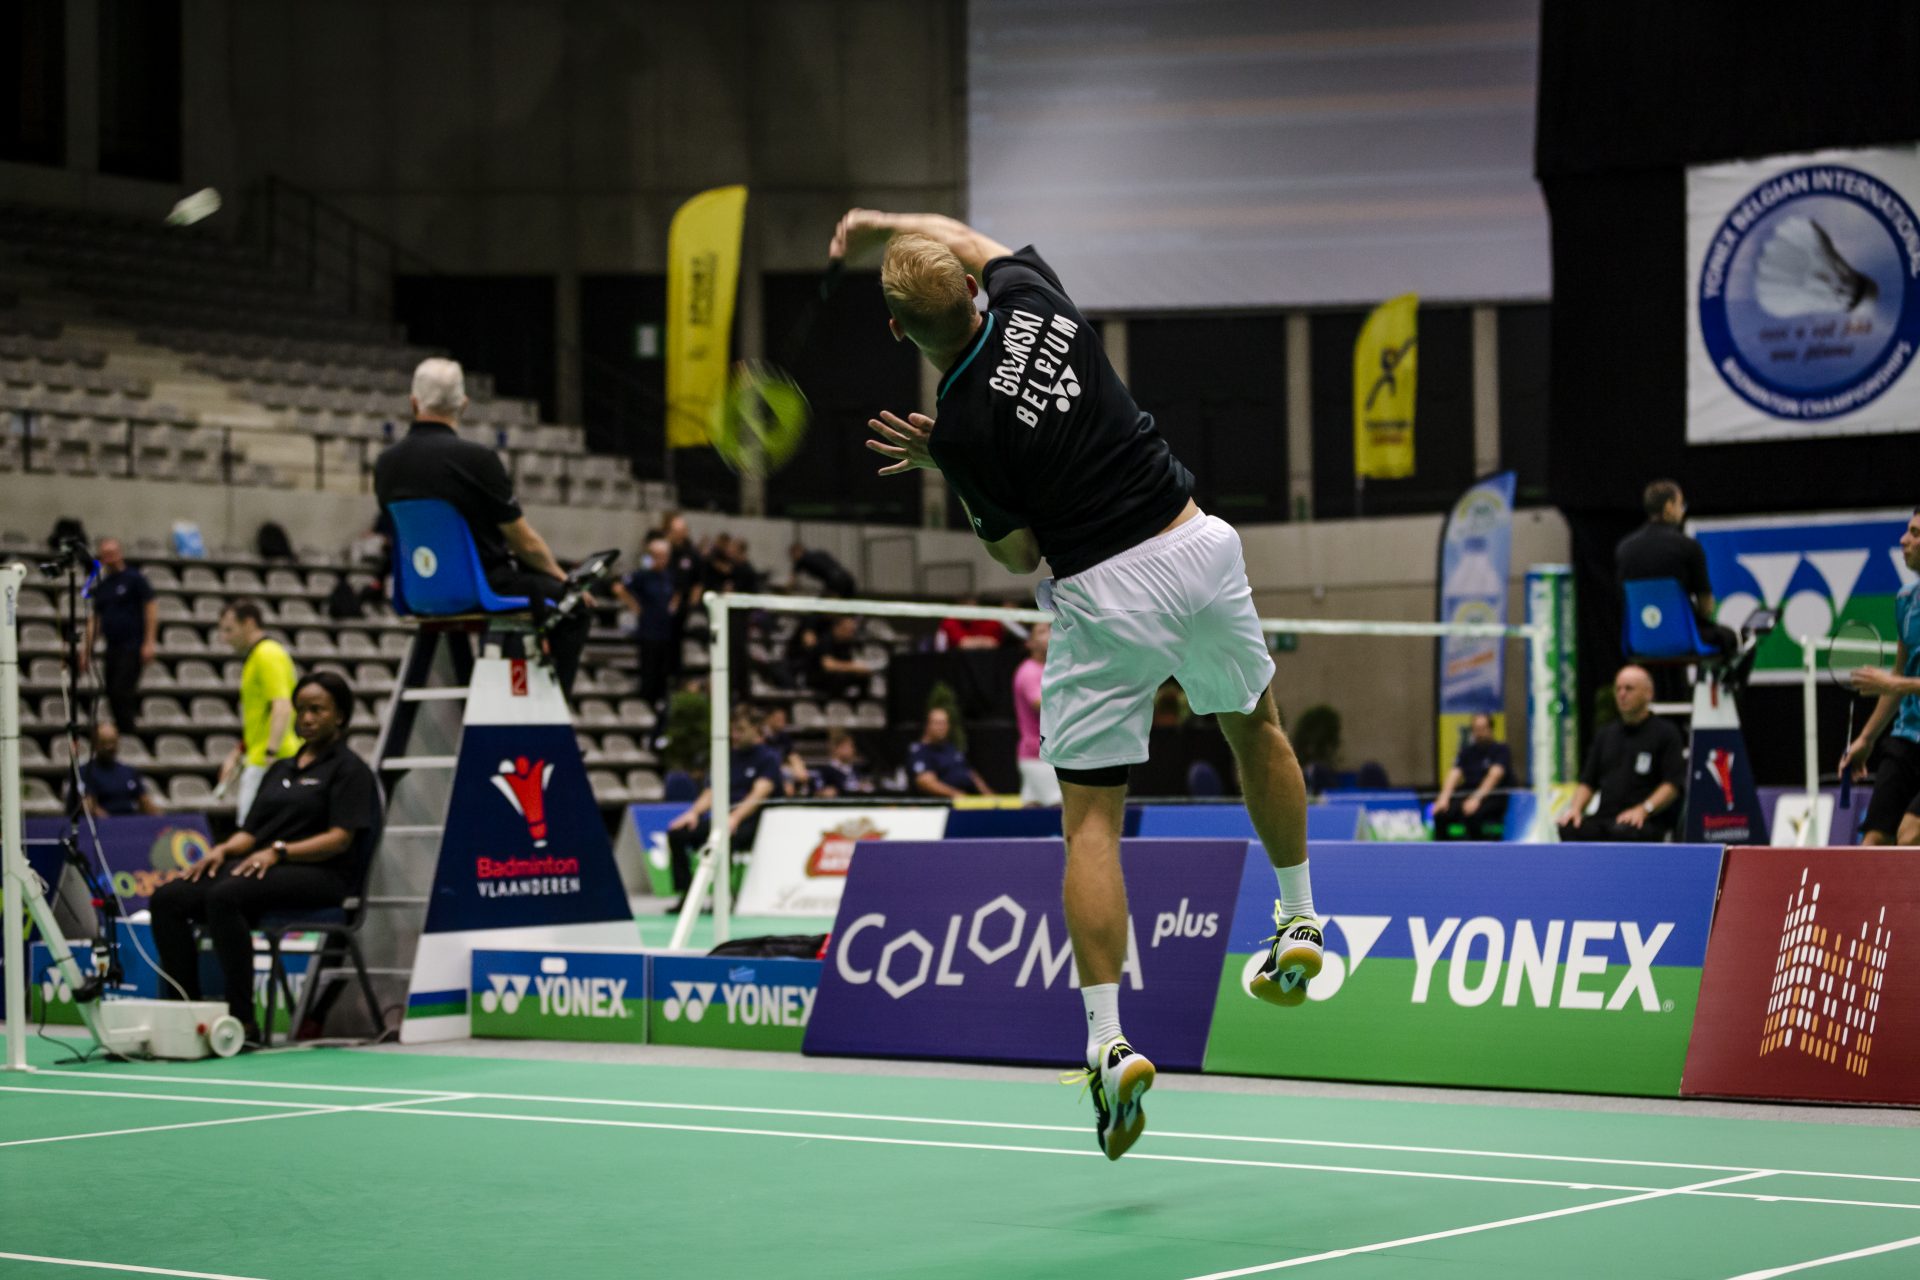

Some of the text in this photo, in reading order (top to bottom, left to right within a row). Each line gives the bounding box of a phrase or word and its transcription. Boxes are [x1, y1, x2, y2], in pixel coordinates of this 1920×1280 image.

[1731, 172, 1810, 231] BELGIAN
[1015, 313, 1079, 429] BELGIUM
[513, 666, 527, 694] 2
[476, 857, 579, 878] Badminton
[477, 877, 580, 897] VLAANDEREN
[1151, 898, 1219, 948] plus
[1408, 916, 1675, 1012] YONEX
[535, 976, 628, 1018] YONEX
